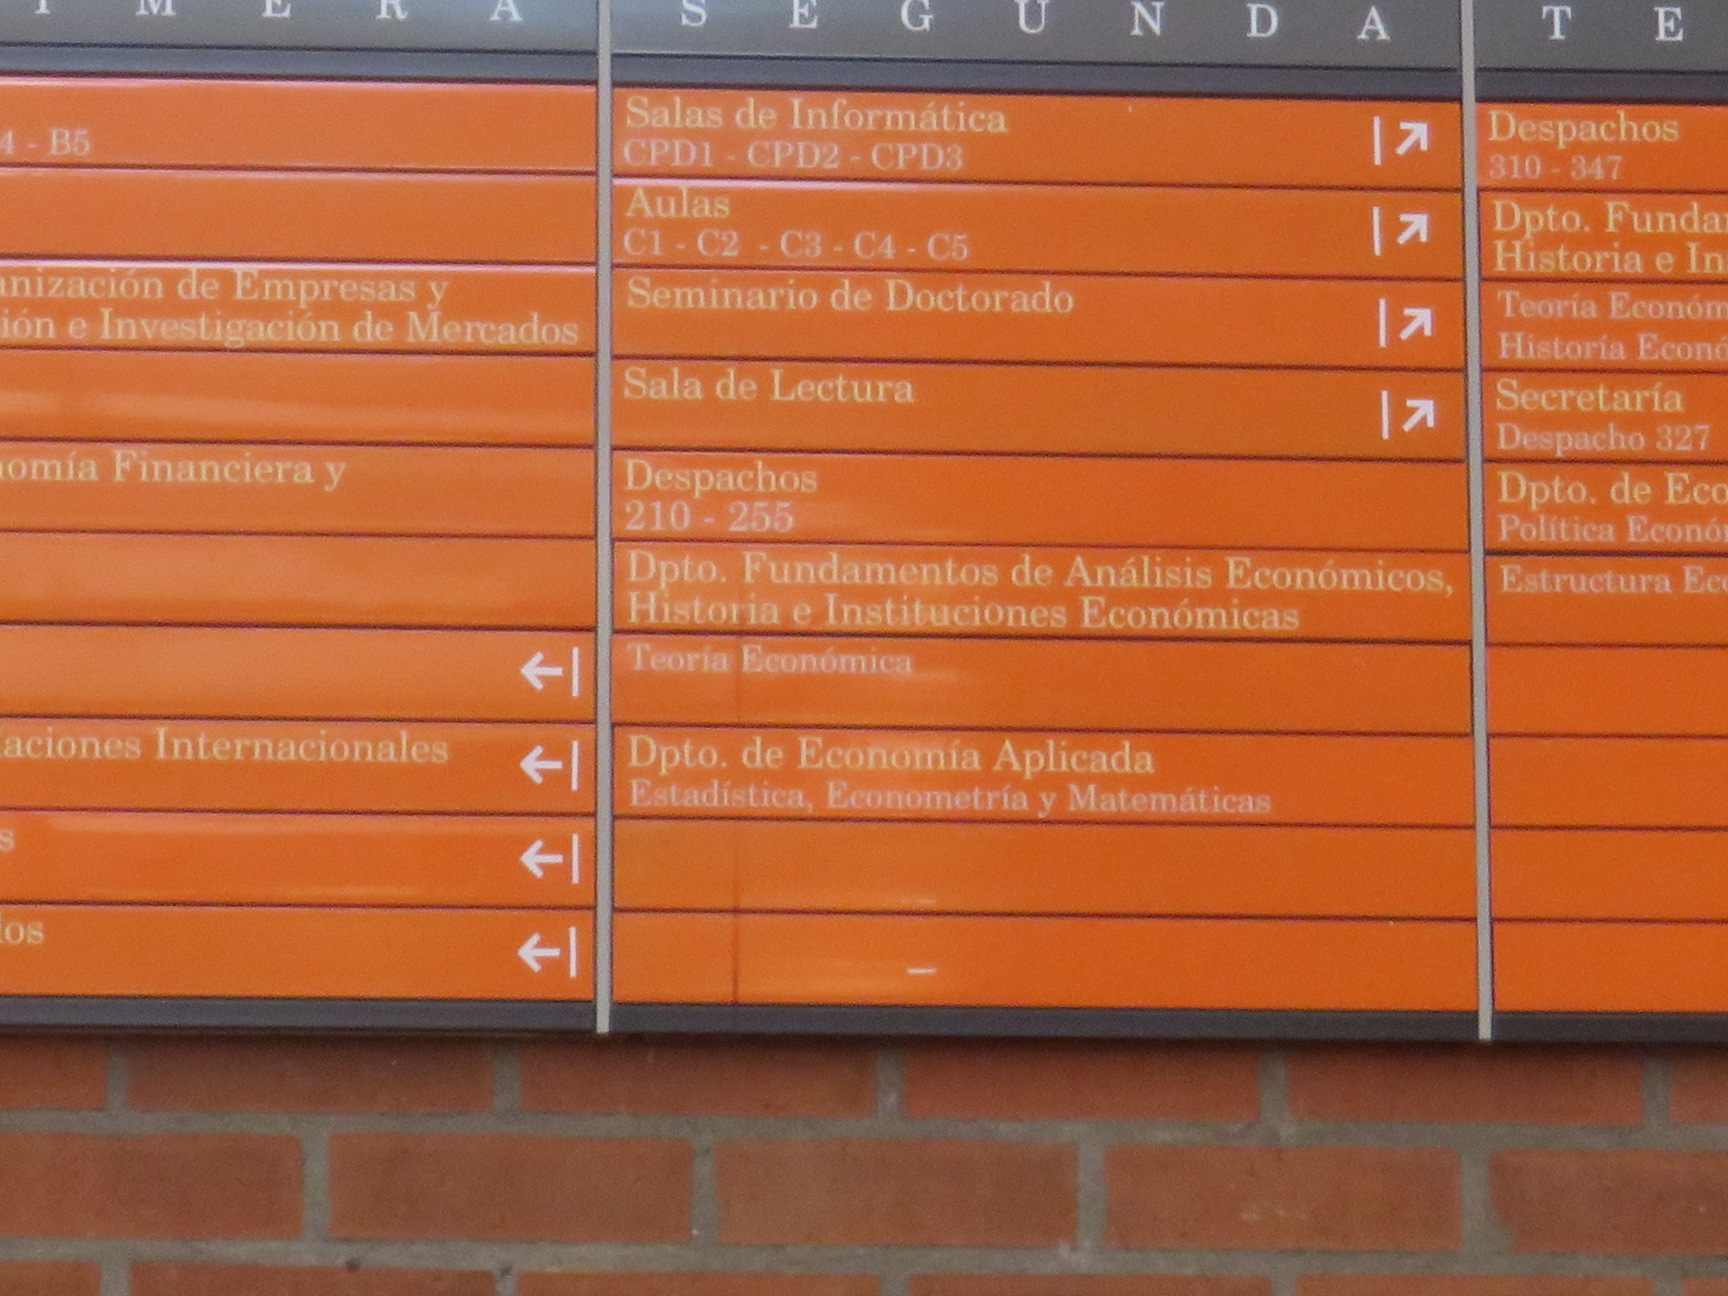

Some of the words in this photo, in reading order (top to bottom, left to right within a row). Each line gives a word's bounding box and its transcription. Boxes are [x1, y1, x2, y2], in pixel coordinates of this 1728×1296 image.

[626, 93, 723, 129] Salas
[734, 94, 778, 130] de
[789, 94, 1008, 132] Informática
[1488, 107, 1680, 151] Despachos
[622, 138, 713, 168] CPD1
[746, 140, 840, 170] CPD2
[870, 142, 964, 172] CPD3
[625, 185, 730, 219] Aulas
[1492, 197, 1591, 242] Dpto.
[1493, 239, 1645, 274] Historia
[177, 270, 220, 300] de
[234, 270, 416, 308] Empresas
[627, 275, 820, 311] Seminario
[829, 276, 872, 312] de
[884, 276, 1075, 313] Doctorado
[100, 308, 341, 348] Investigación
[352, 311, 393, 343] de
[406, 311, 579, 346] Mercados
[623, 365, 703, 399] Sala
[715, 365, 758, 402] de
[770, 367, 916, 404] Lectura
[1495, 377, 1685, 414] Secretaría
[1495, 420, 1646, 460] Despacho
[1655, 423, 1710, 453] 327
[112, 447, 315, 485] Financiera
[624, 455, 818, 500] Despachos
[1497, 469, 1596, 514] Dpto.
[1609, 470, 1652, 508] de
[624, 498, 692, 532] 210
[728, 500, 795, 533] 255
[1497, 511, 1616, 544] Política
[627, 548, 726, 593] Dpto.
[742, 549, 998, 587] Fundamentos
[1010, 551, 1054, 588] de
[1064, 553, 1212, 591] Análisis
[1224, 555, 1454, 600] Económicos,
[1499, 562, 1673, 595] Estructura
[628, 589, 781, 627] Historia
[825, 590, 1067, 628] Instituciones
[1079, 594, 1299, 630] Económicas
[155, 726, 448, 763] Internacionales
[627, 732, 727, 777] Dpto.
[741, 733, 784, 769] de
[797, 733, 981, 771] Economía
[992, 737, 1154, 782] Aplicada
[629, 777, 814, 815] Estadística,
[825, 778, 1030, 812] Econometría
[1066, 780, 1271, 814] Matemáticas
